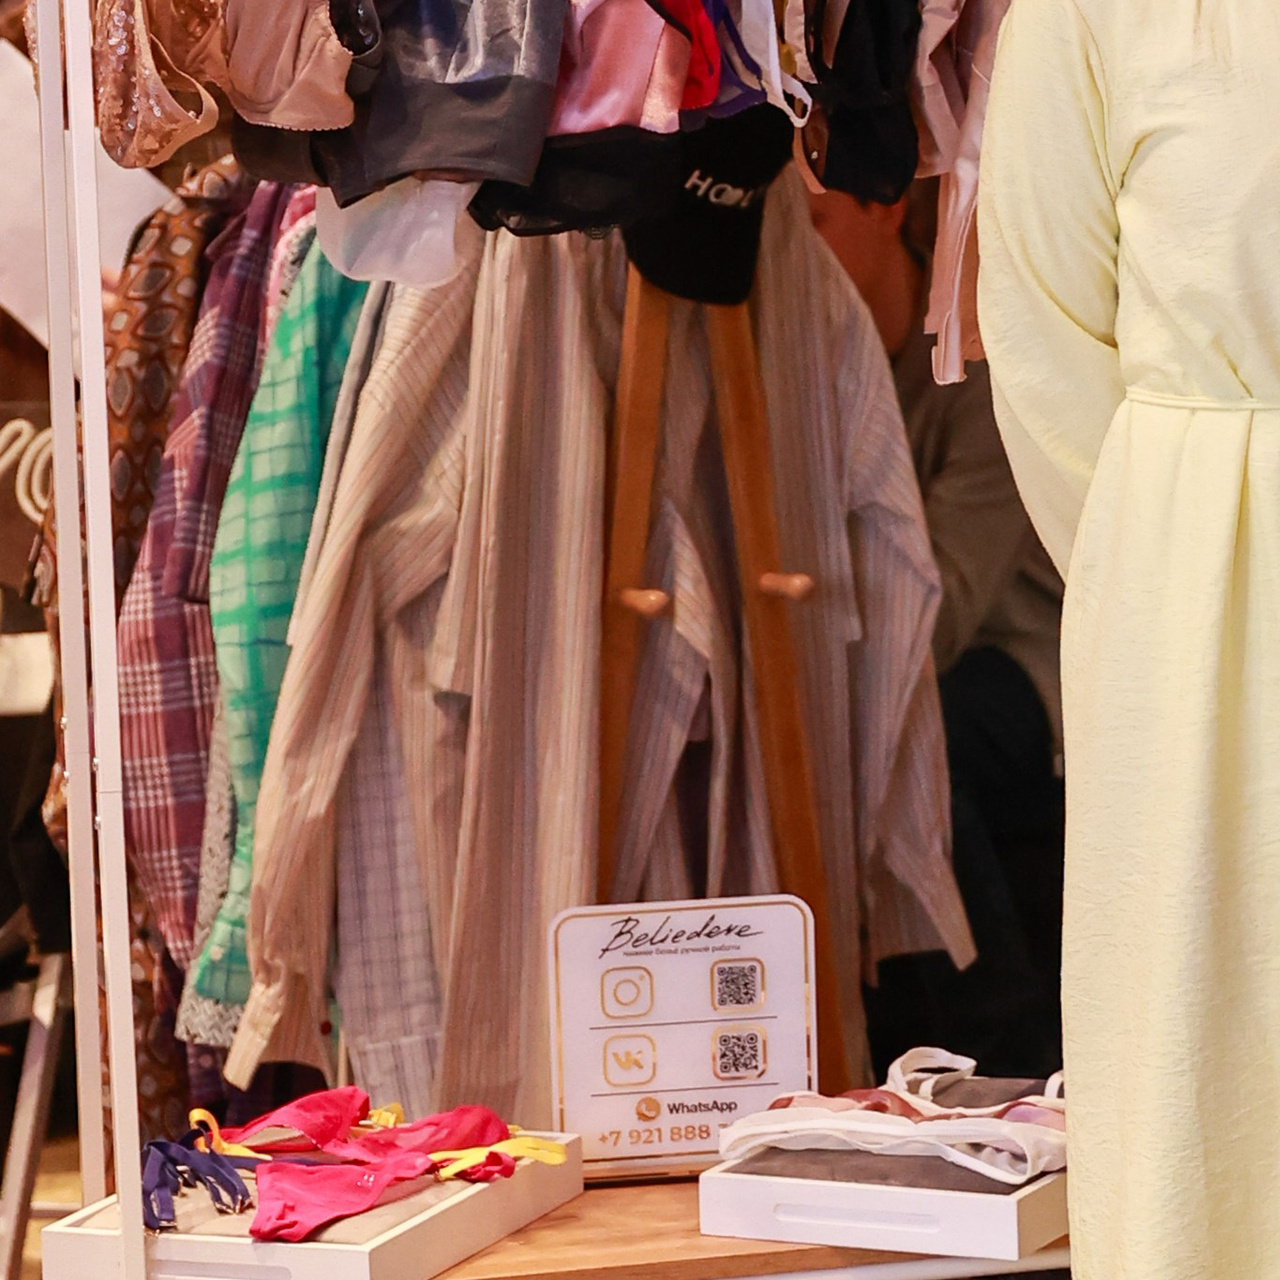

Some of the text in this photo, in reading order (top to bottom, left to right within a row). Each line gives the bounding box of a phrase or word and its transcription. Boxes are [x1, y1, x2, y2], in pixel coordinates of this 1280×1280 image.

[666, 1099, 738, 1115] WhatsApp
[598, 1124, 711, 1147] +7 921 888
